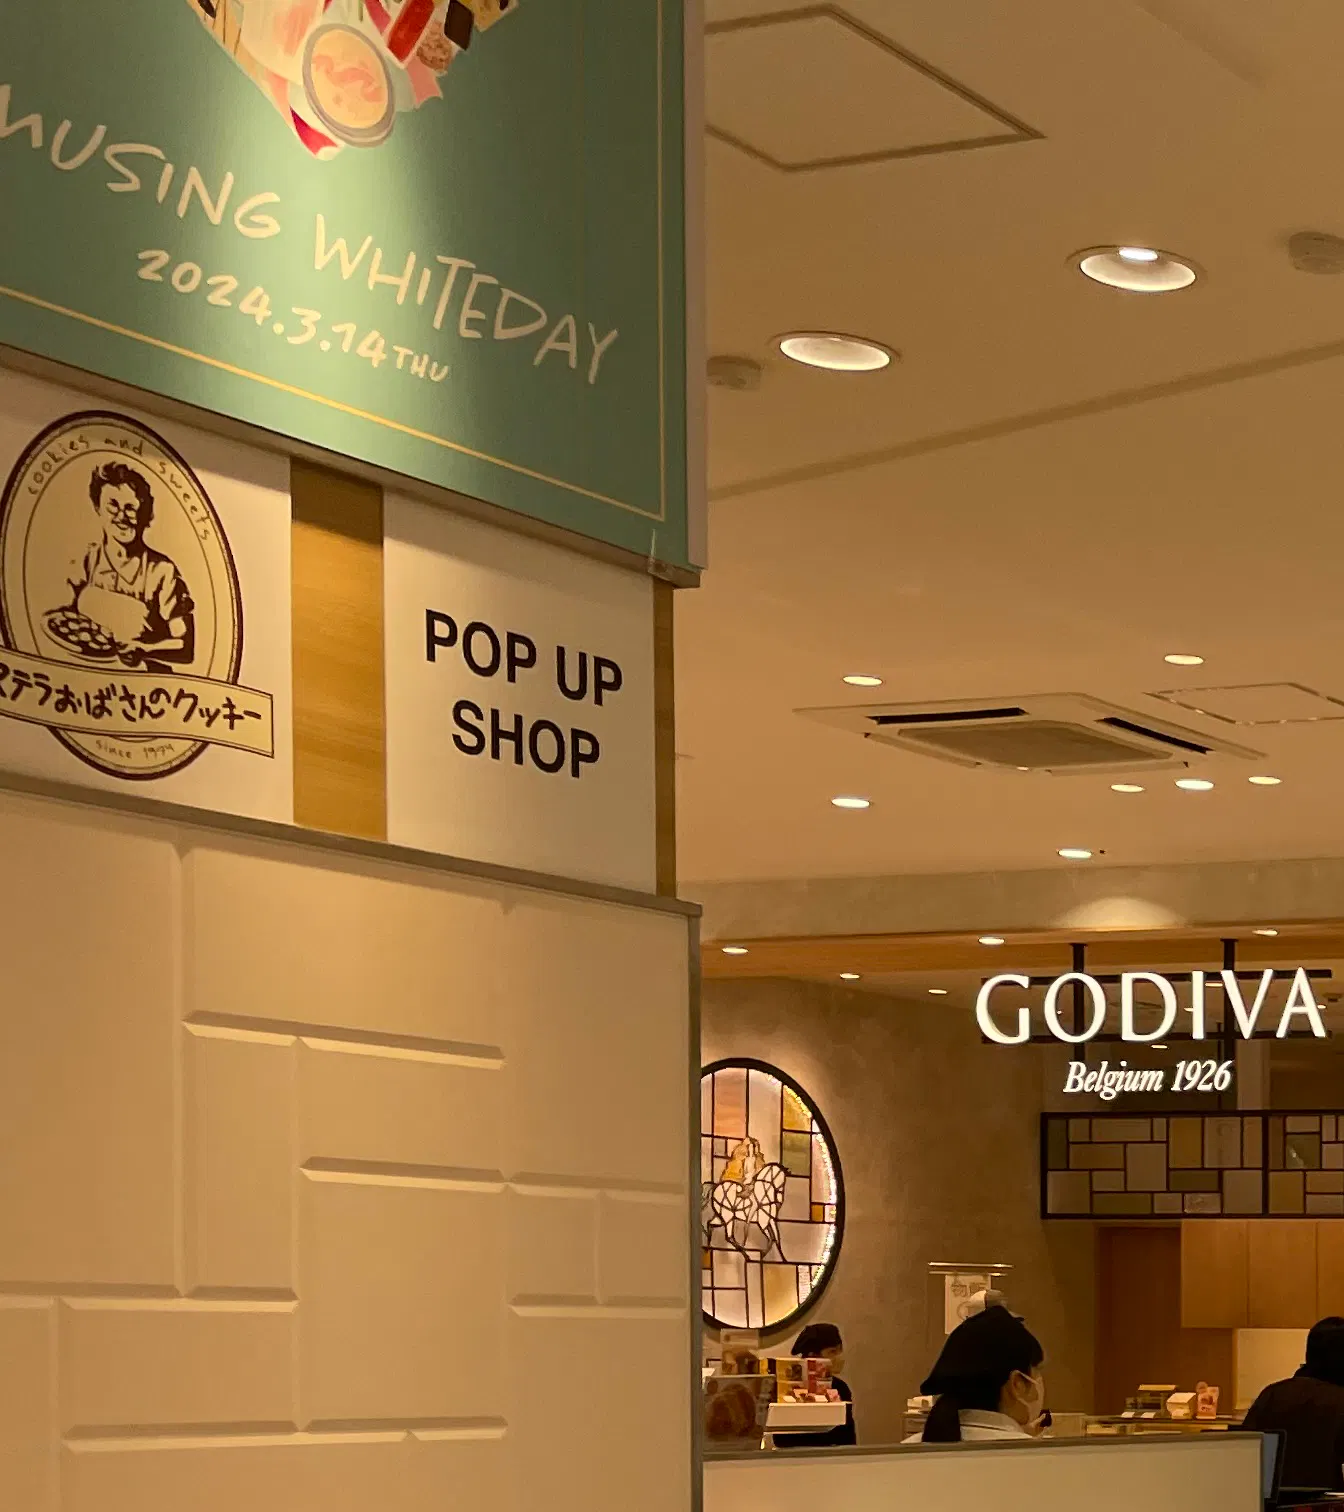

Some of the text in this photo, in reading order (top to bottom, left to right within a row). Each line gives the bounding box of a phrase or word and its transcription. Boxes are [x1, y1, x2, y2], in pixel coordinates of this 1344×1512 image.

[314, 213, 619, 386] WHITEDAY
[27, 434, 211, 541] cookies and sweets
[424, 608, 624, 707] POP UP
[451, 699, 601, 779] SHOP
[975, 967, 1327, 1045] GODIVA
[1062, 1059, 1234, 1100] Belgium 1926
